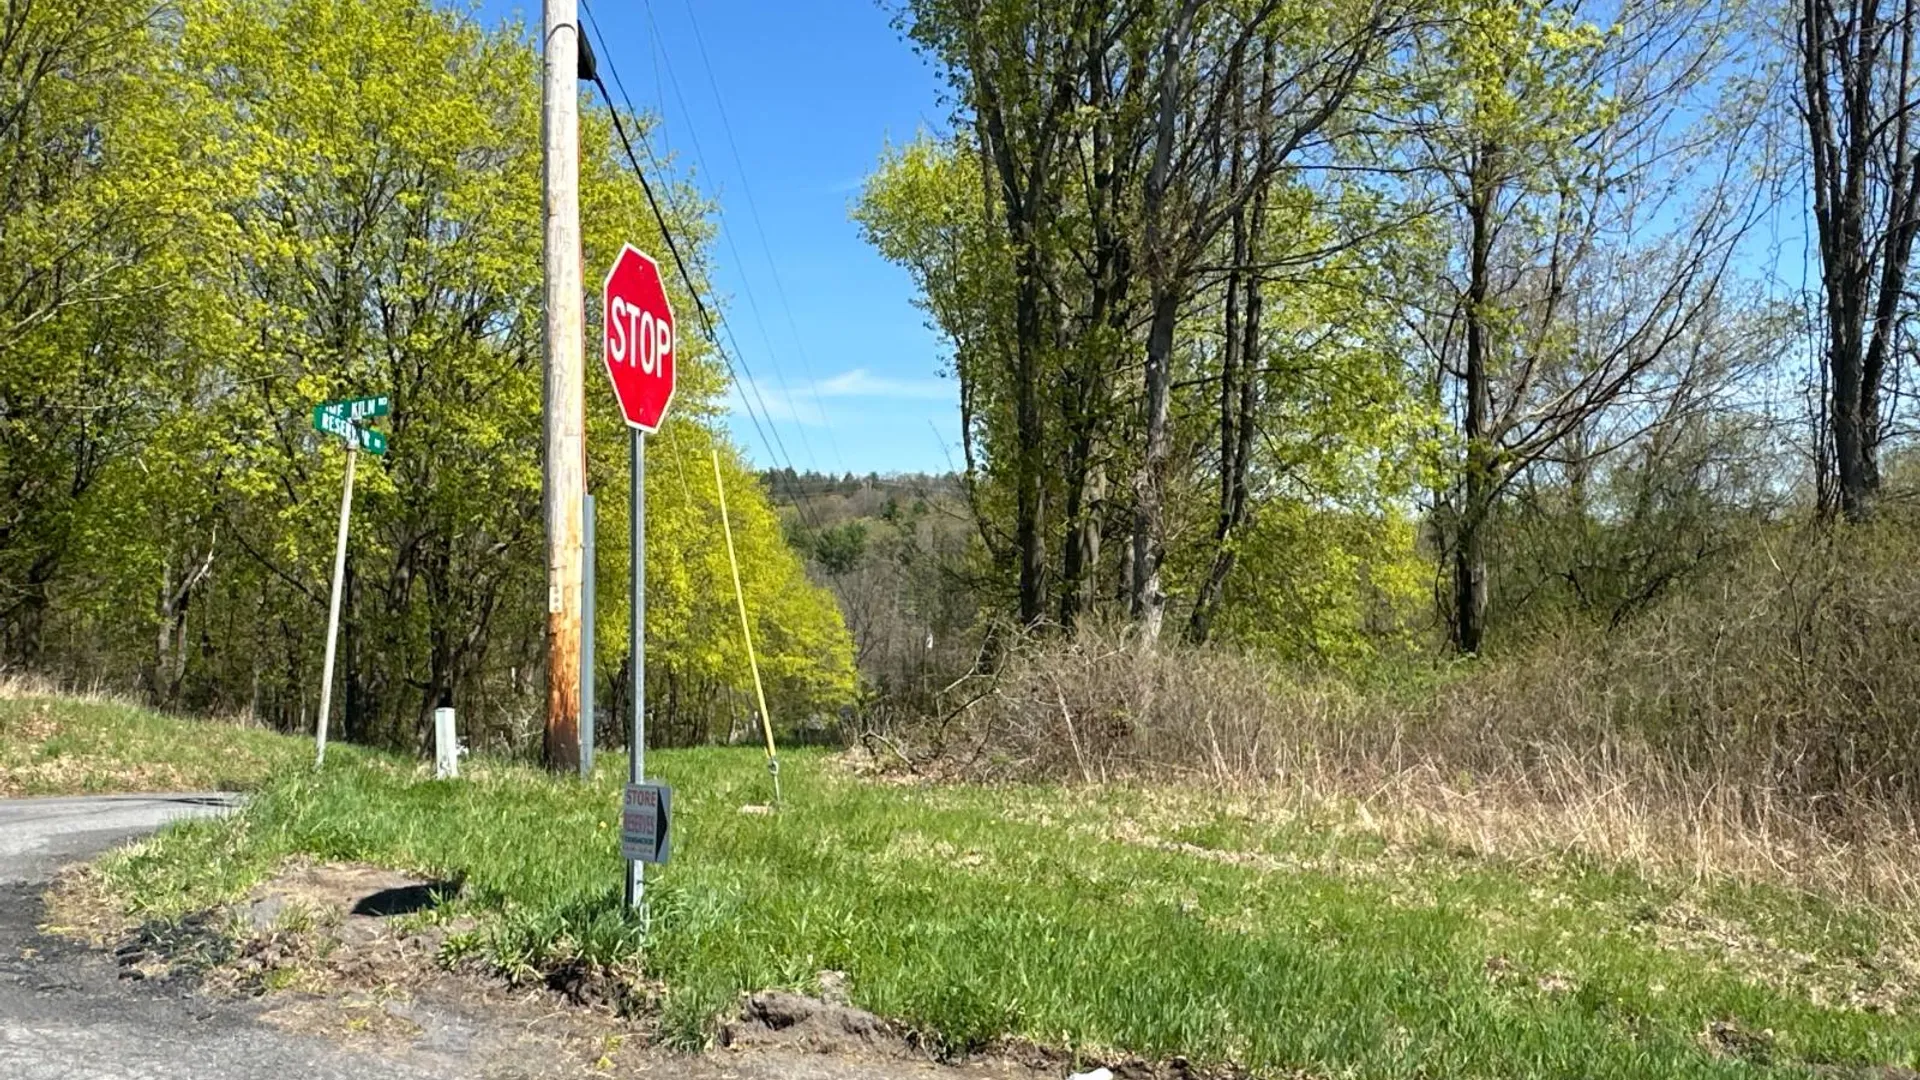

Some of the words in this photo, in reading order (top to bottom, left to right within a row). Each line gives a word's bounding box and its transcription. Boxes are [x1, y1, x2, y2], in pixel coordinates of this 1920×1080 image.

[610, 295, 671, 378] STOP
[351, 399, 375, 417] KILN
[626, 789, 656, 807] STORE
